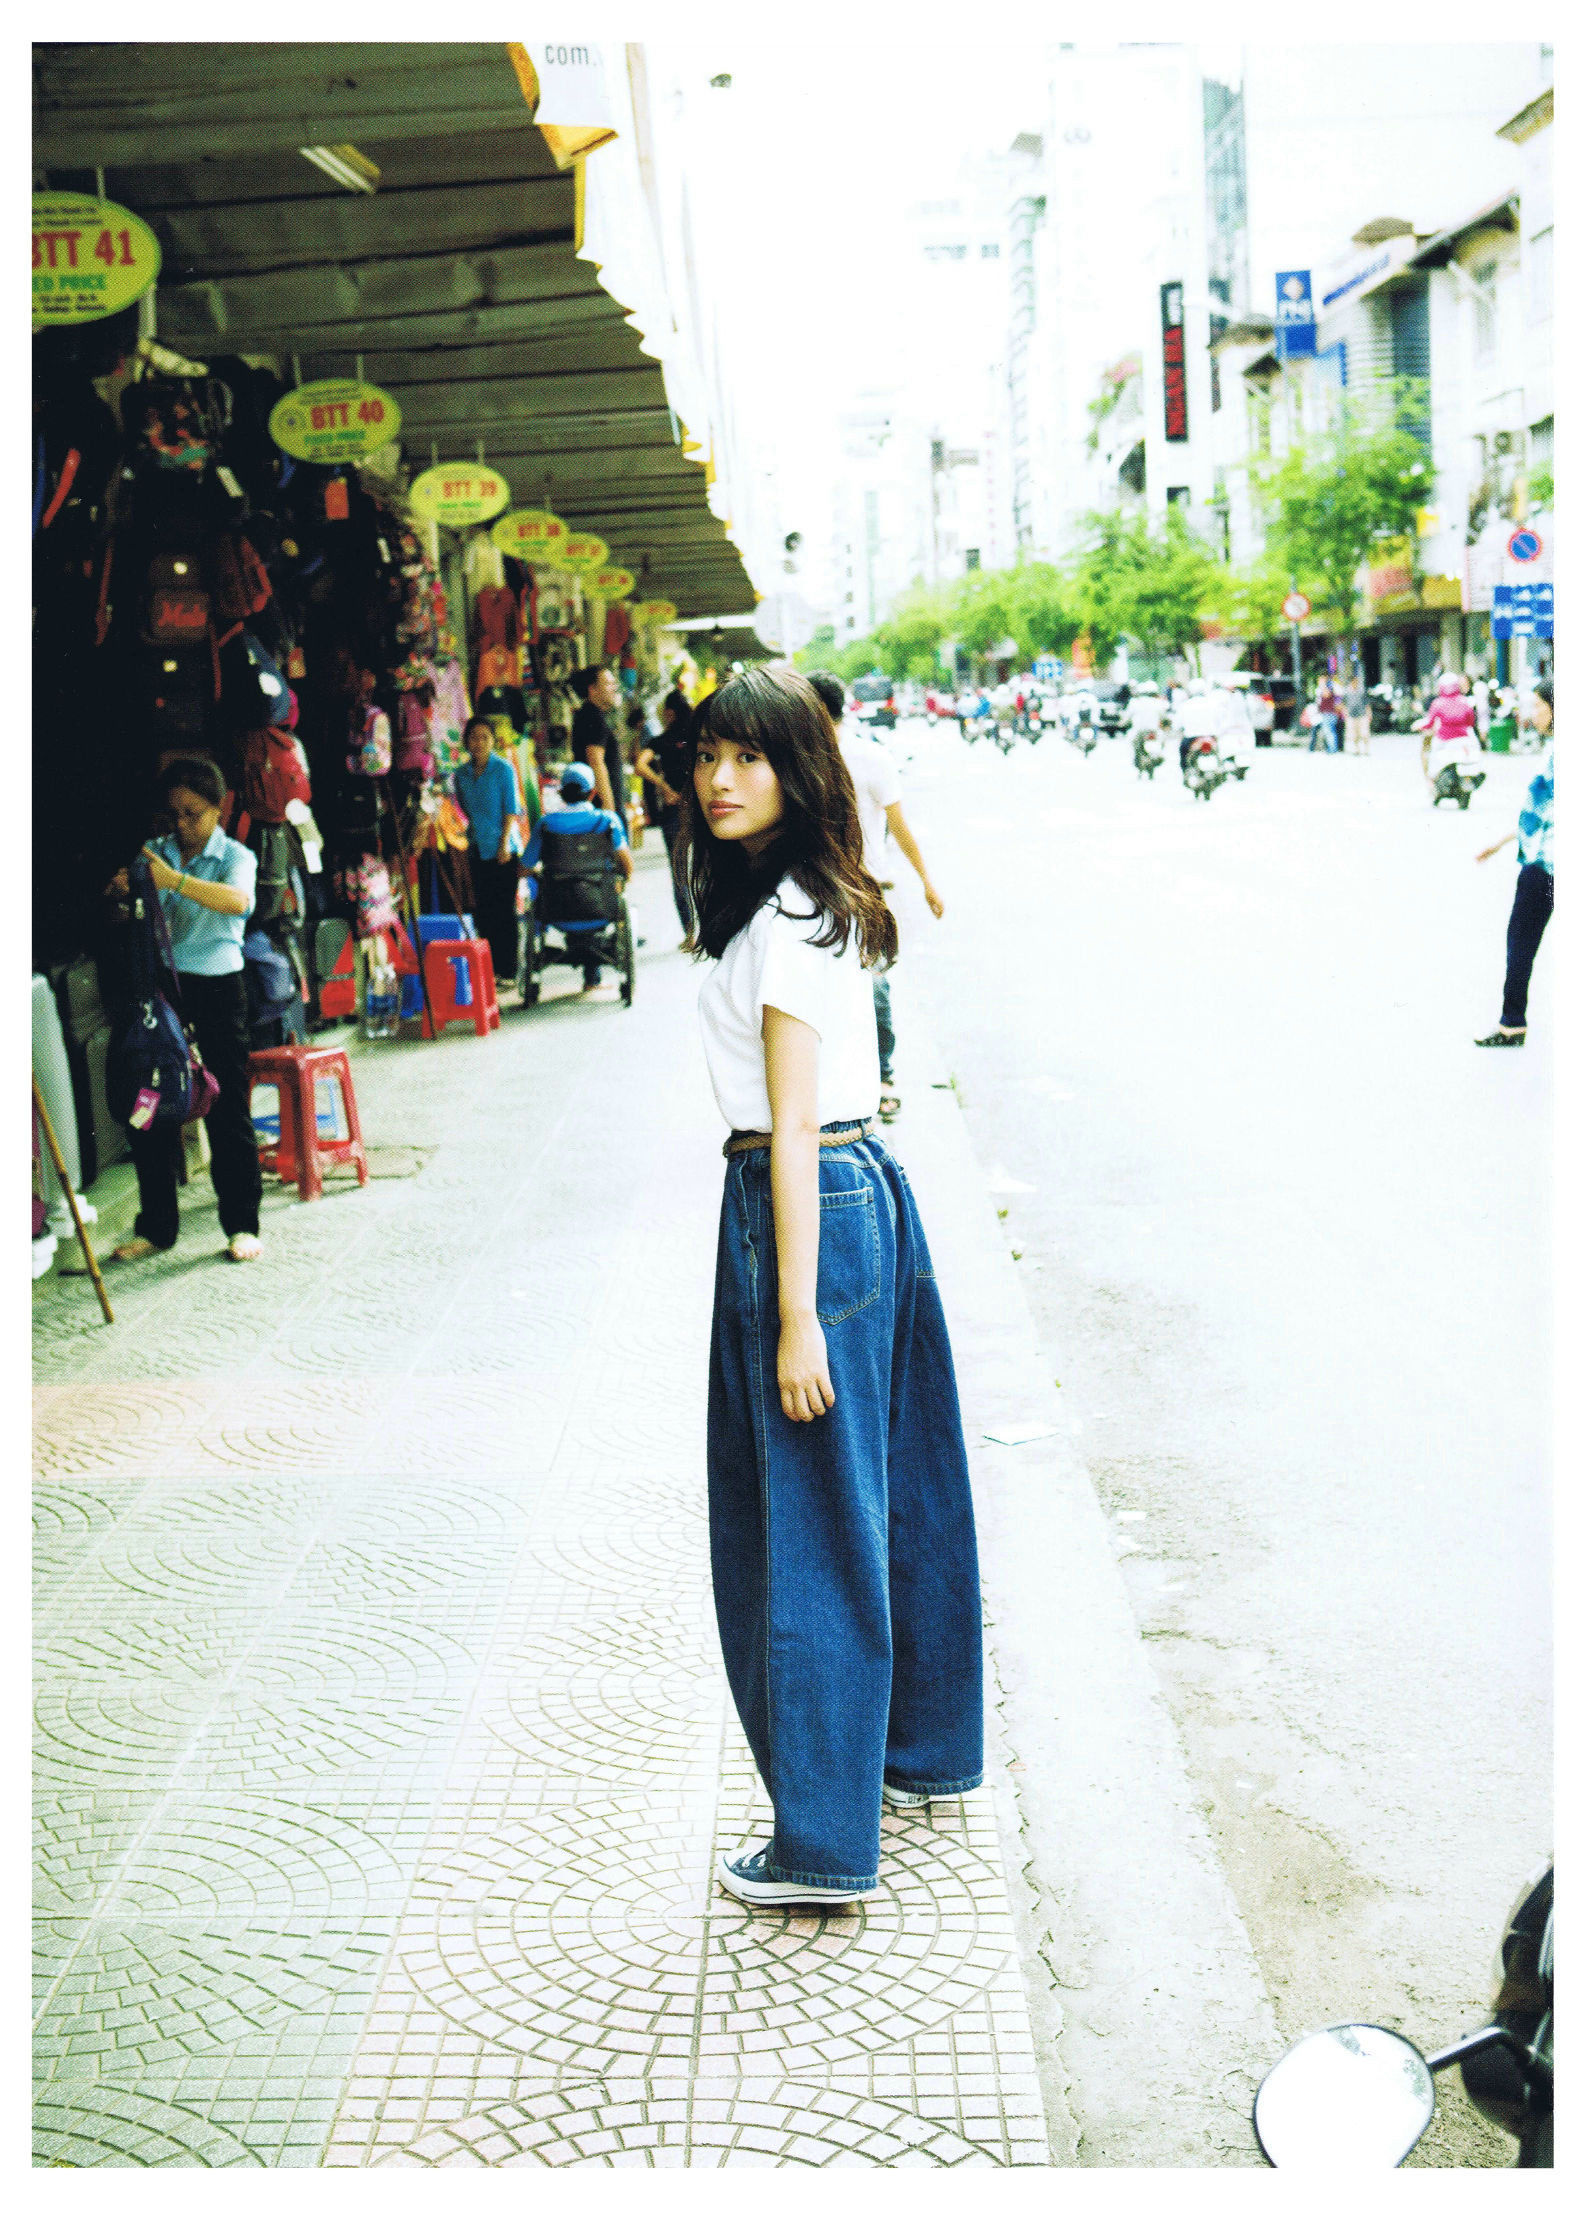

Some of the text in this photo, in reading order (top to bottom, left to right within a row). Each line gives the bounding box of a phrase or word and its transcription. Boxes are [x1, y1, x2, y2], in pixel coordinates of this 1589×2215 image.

[95, 229, 136, 266] 41
[311, 400, 385, 430] BTT 40
[443, 480, 471, 498] BTT
